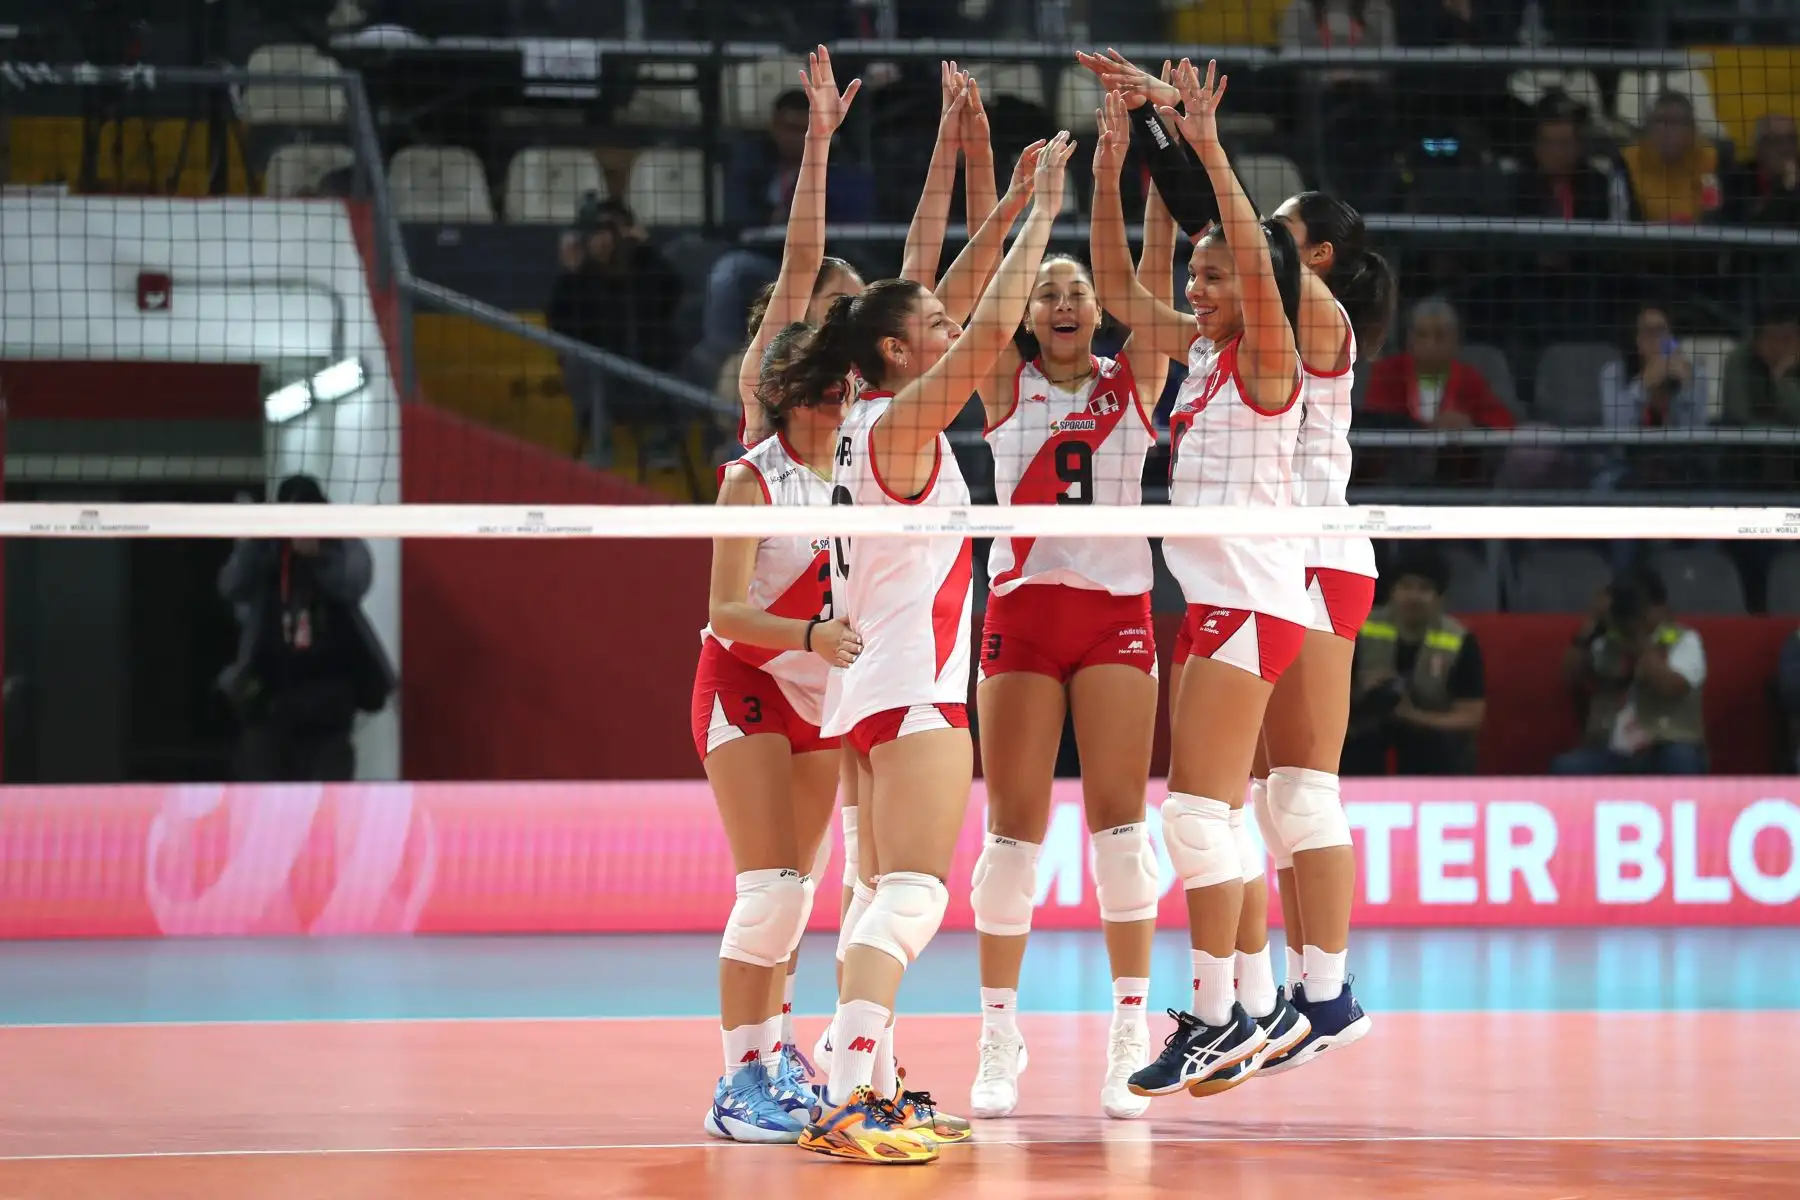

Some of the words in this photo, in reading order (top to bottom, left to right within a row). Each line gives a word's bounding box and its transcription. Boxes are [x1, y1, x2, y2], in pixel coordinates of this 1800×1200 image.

[1060, 420, 1095, 430] SPORADE
[1054, 441, 1094, 505] 9
[742, 696, 763, 723] 3
